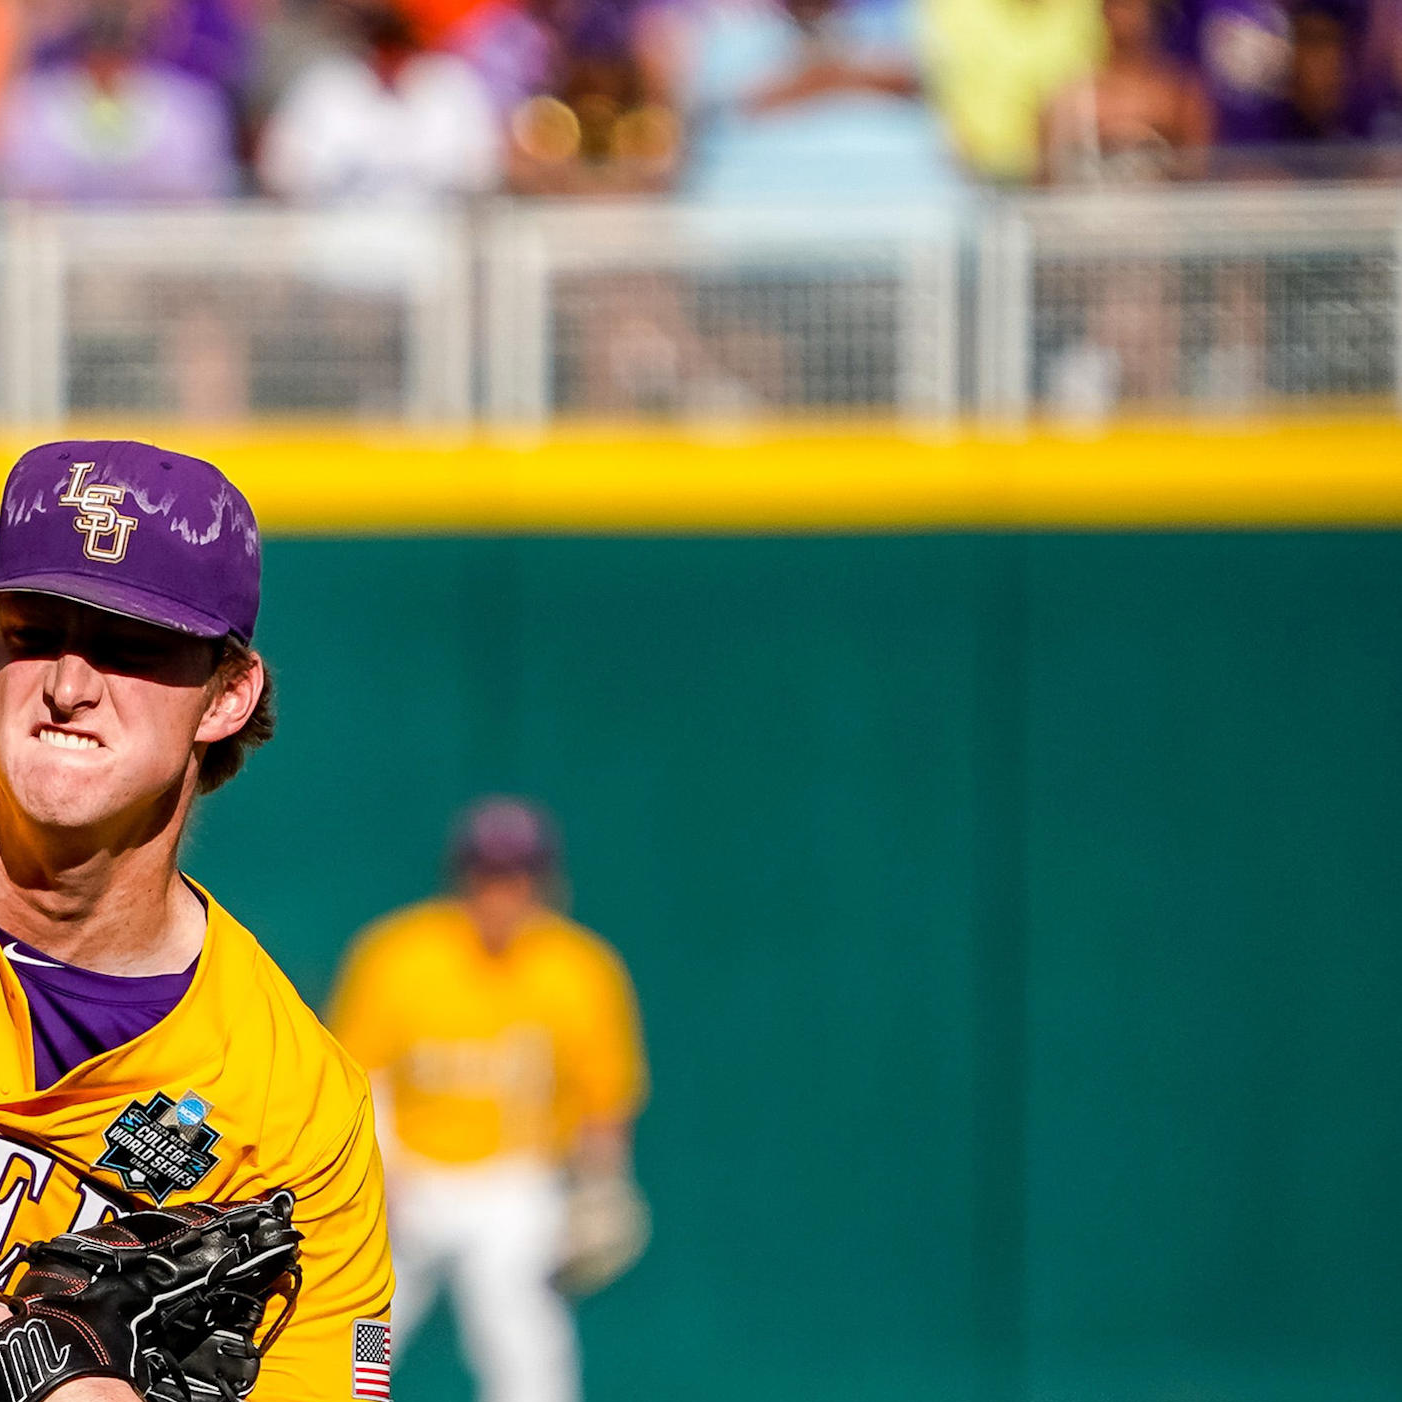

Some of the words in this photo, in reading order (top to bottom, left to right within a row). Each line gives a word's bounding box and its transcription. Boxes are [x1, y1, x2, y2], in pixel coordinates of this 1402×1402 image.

[58, 461, 138, 564] LSU
[108, 1125, 155, 1161] WORLD
[150, 1155, 196, 1187] SERIES
[129, 1157, 160, 1179] OMAHA
[135, 1125, 191, 1167] COLLEGE
